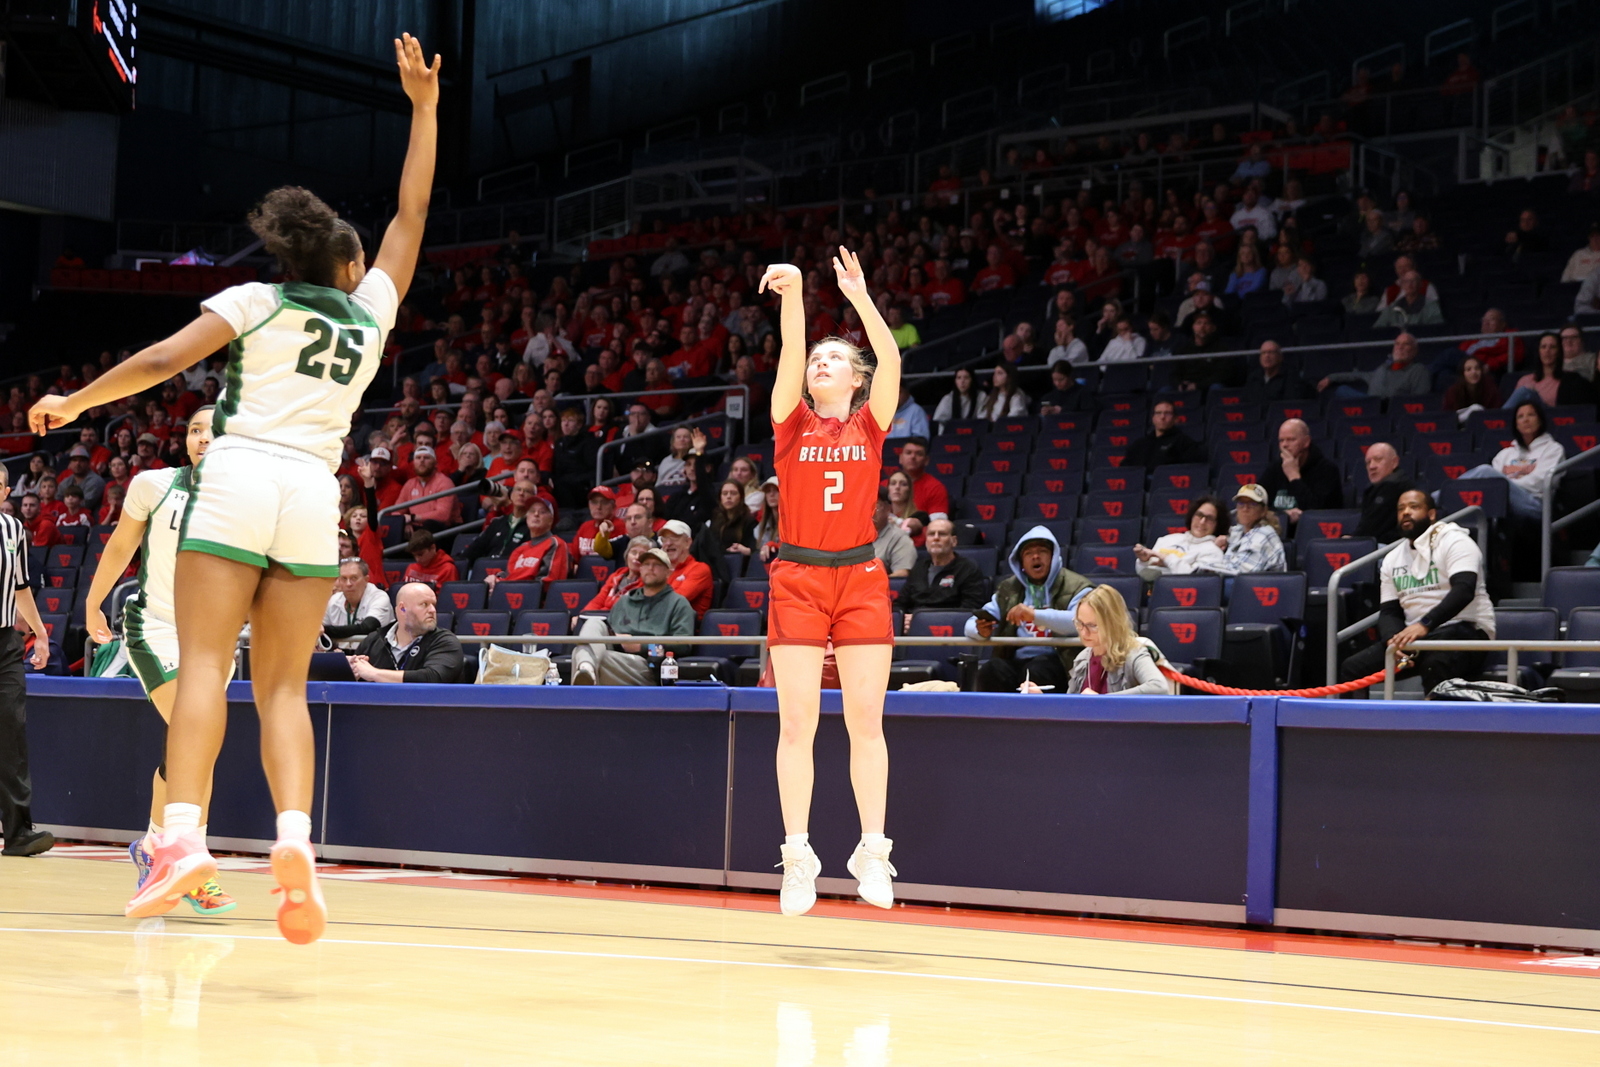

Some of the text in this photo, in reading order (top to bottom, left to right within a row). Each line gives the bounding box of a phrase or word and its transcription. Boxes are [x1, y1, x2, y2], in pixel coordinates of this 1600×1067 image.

[295, 317, 364, 386] 25
[799, 445, 867, 462] BELLEVUE
[823, 470, 845, 512] 2
[1393, 568, 1439, 592] MOMNT
